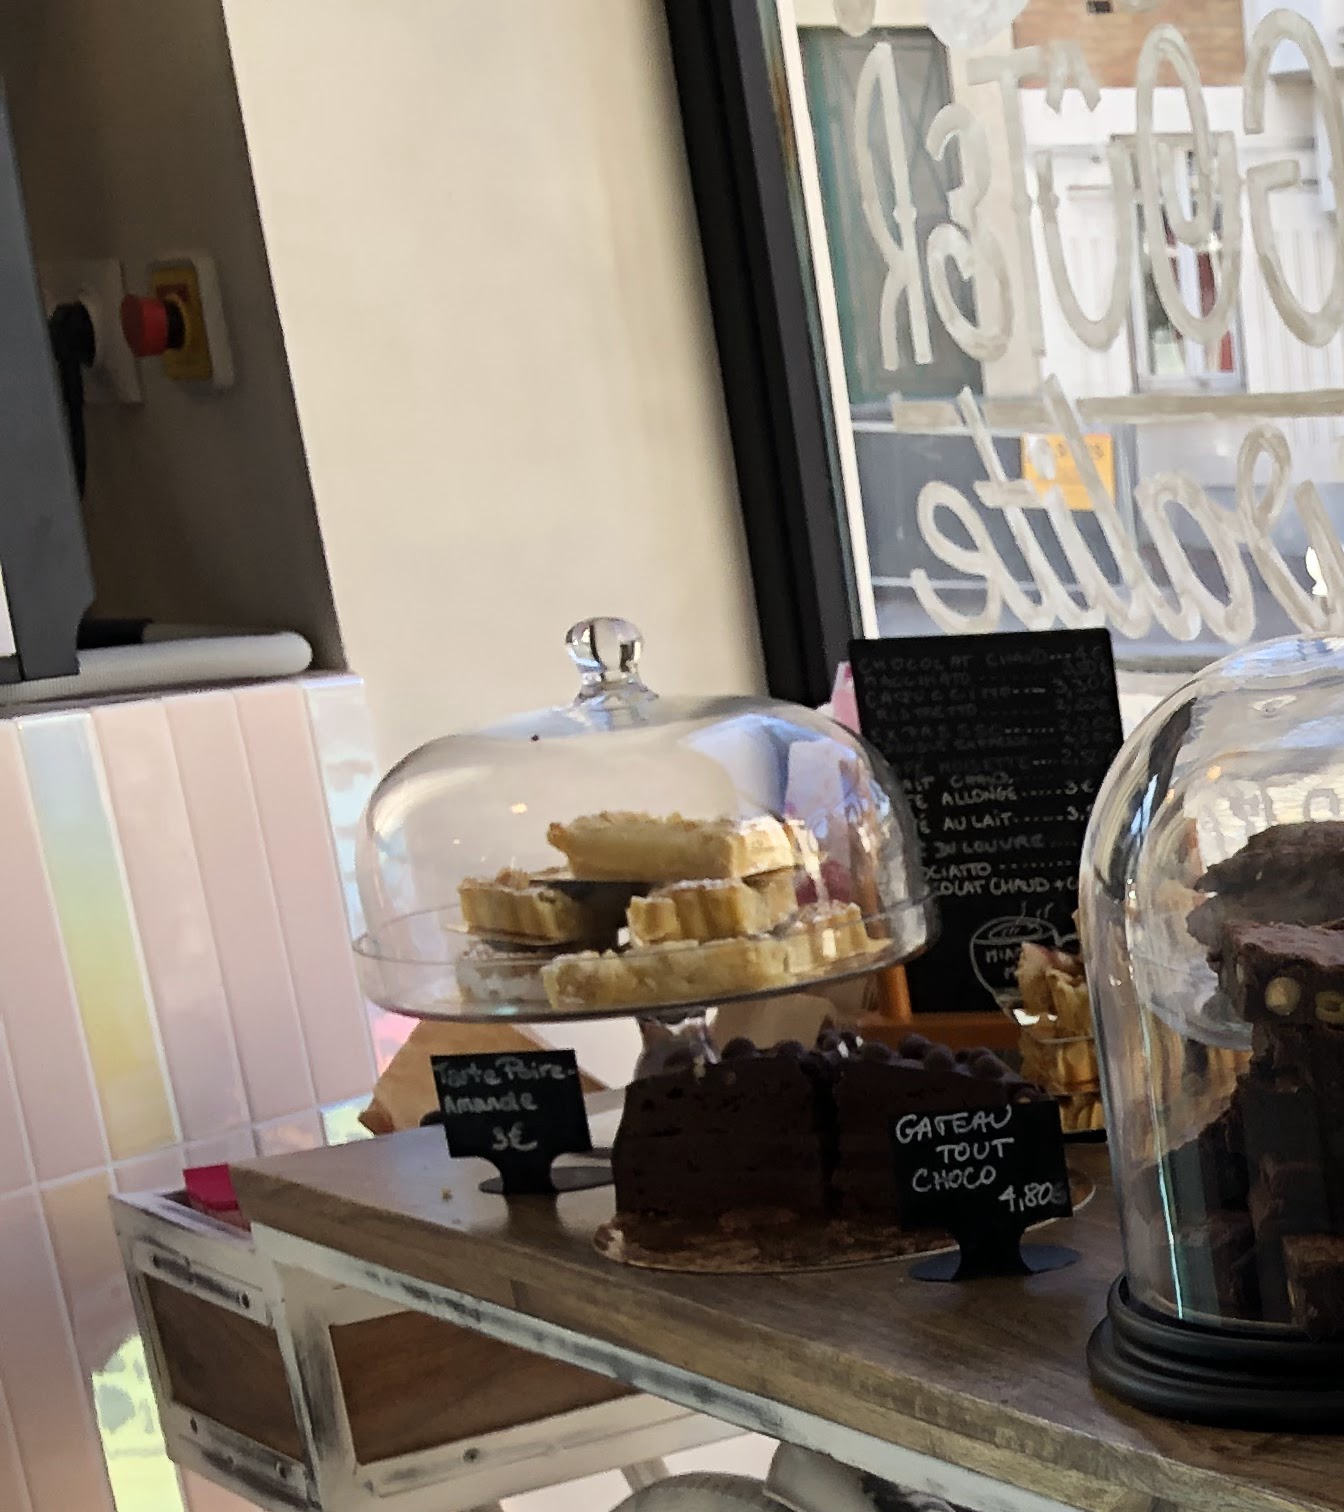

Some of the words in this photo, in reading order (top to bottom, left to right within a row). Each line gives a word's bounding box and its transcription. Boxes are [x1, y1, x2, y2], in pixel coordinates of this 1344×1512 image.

[943, 816, 967, 831] AU
[962, 833, 1045, 854] LOUVRE
[989, 876, 1051, 896] CHAUD
[434, 1060, 502, 1088] Tarte
[443, 1092, 539, 1114] Amande
[491, 1121, 539, 1152] 3€
[895, 1103, 1013, 1145] GATEAU
[935, 1136, 1016, 1164] TOUT
[911, 1165, 998, 1193] CHOCO
